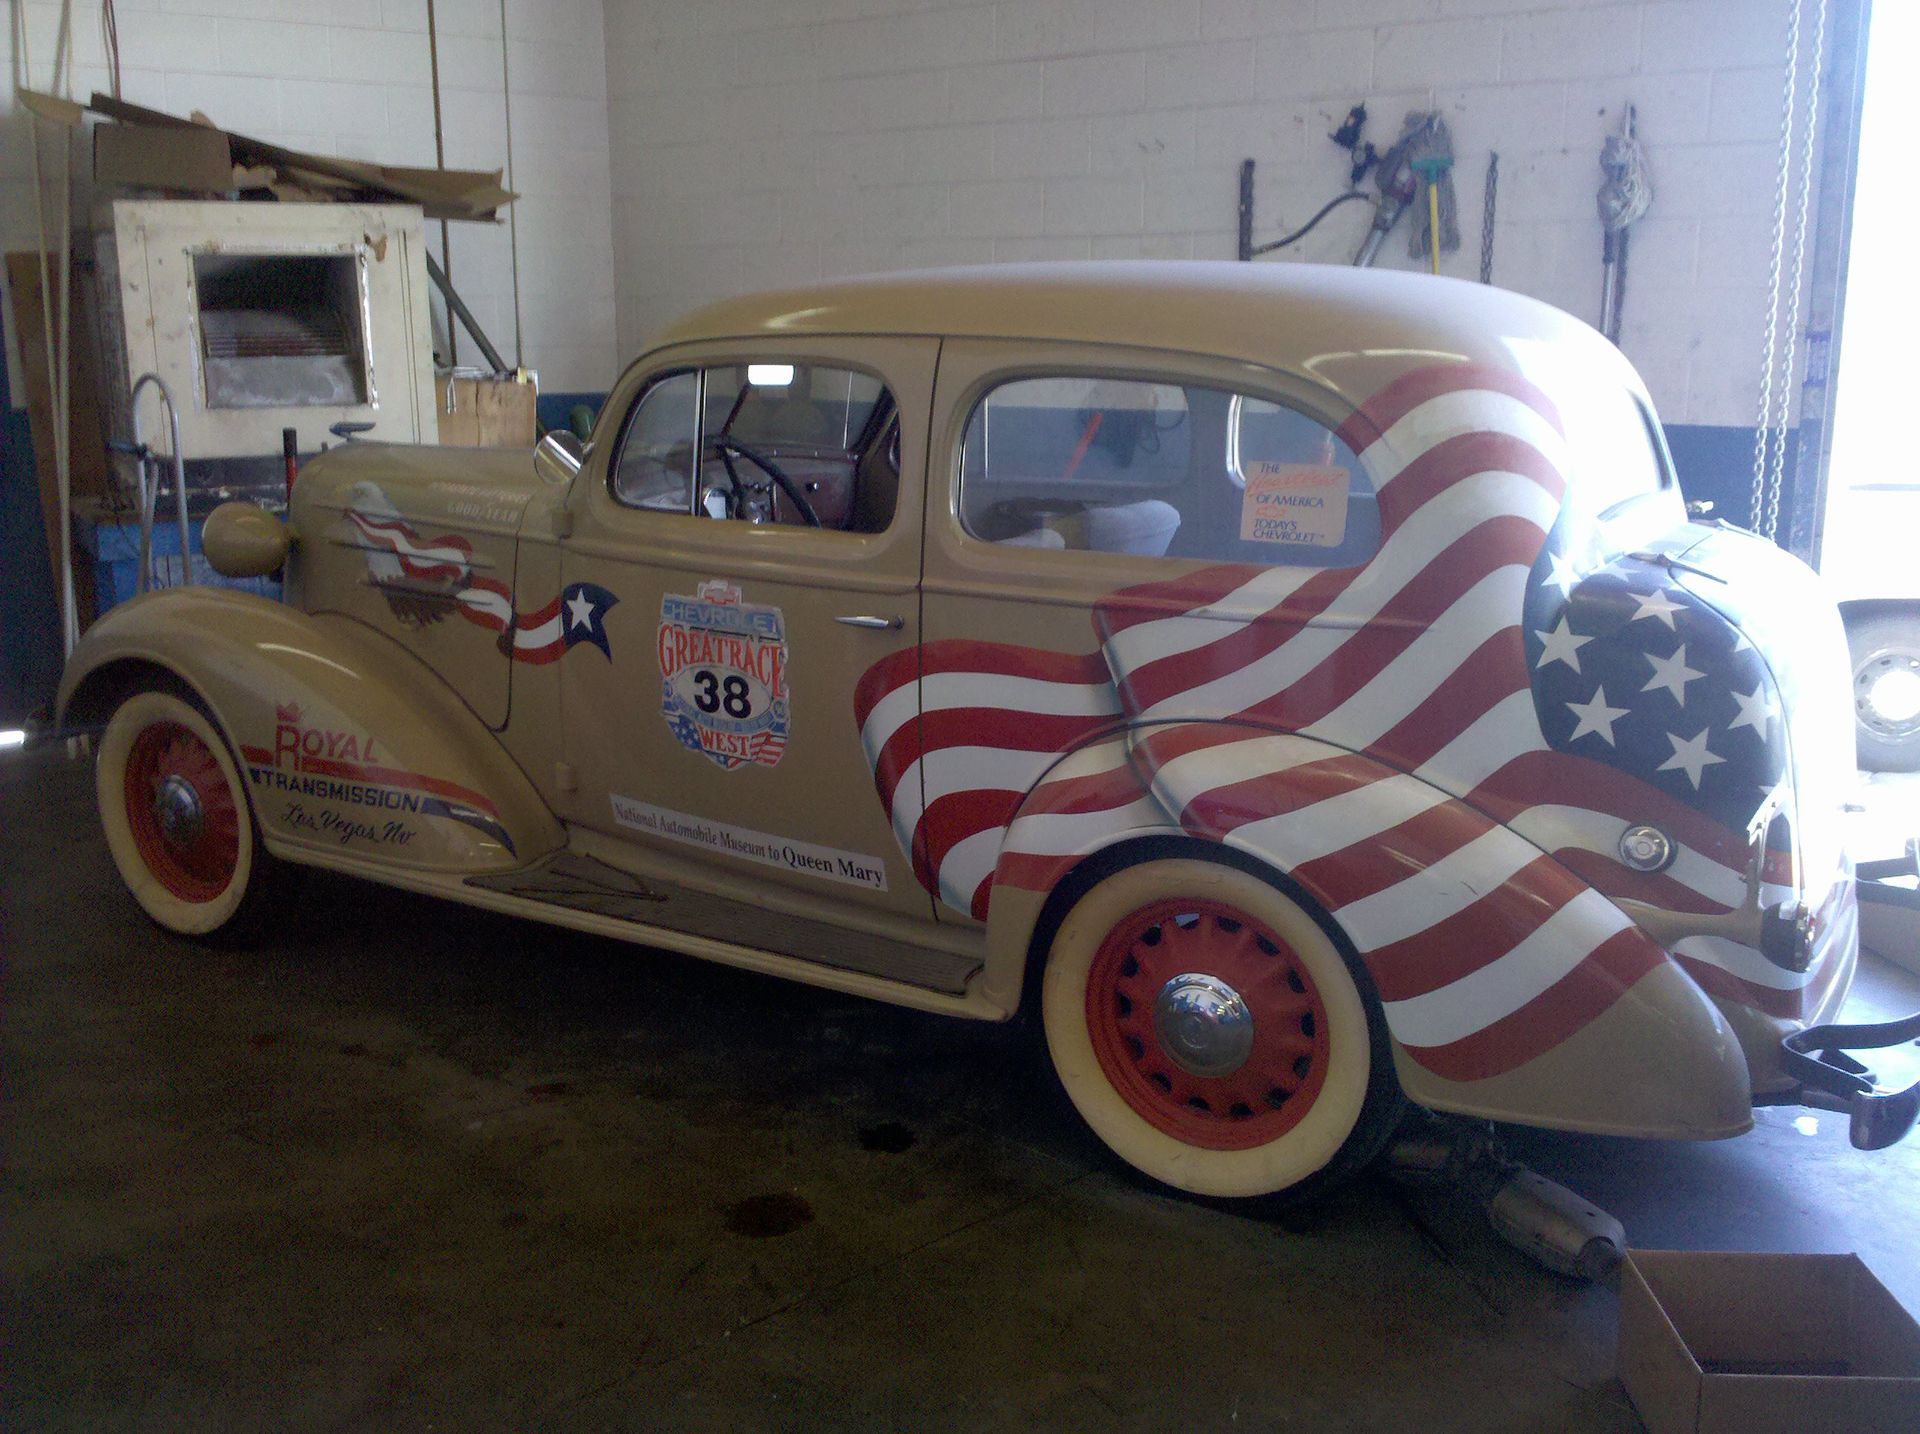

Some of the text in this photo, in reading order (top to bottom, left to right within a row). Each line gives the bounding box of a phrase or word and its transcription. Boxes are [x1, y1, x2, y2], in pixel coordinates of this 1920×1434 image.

[1260, 462, 1280, 473] THE
[1256, 494, 1325, 509] OF AMERICA
[663, 600, 779, 635] CHEVROLET
[694, 670, 752, 719] 38
[276, 724, 379, 770] ROYAL
[700, 726, 750, 757] WEST
[261, 769, 420, 813] TRANSMISSION
[614, 802, 883, 888] National Automobile Museum to Queen Mary
